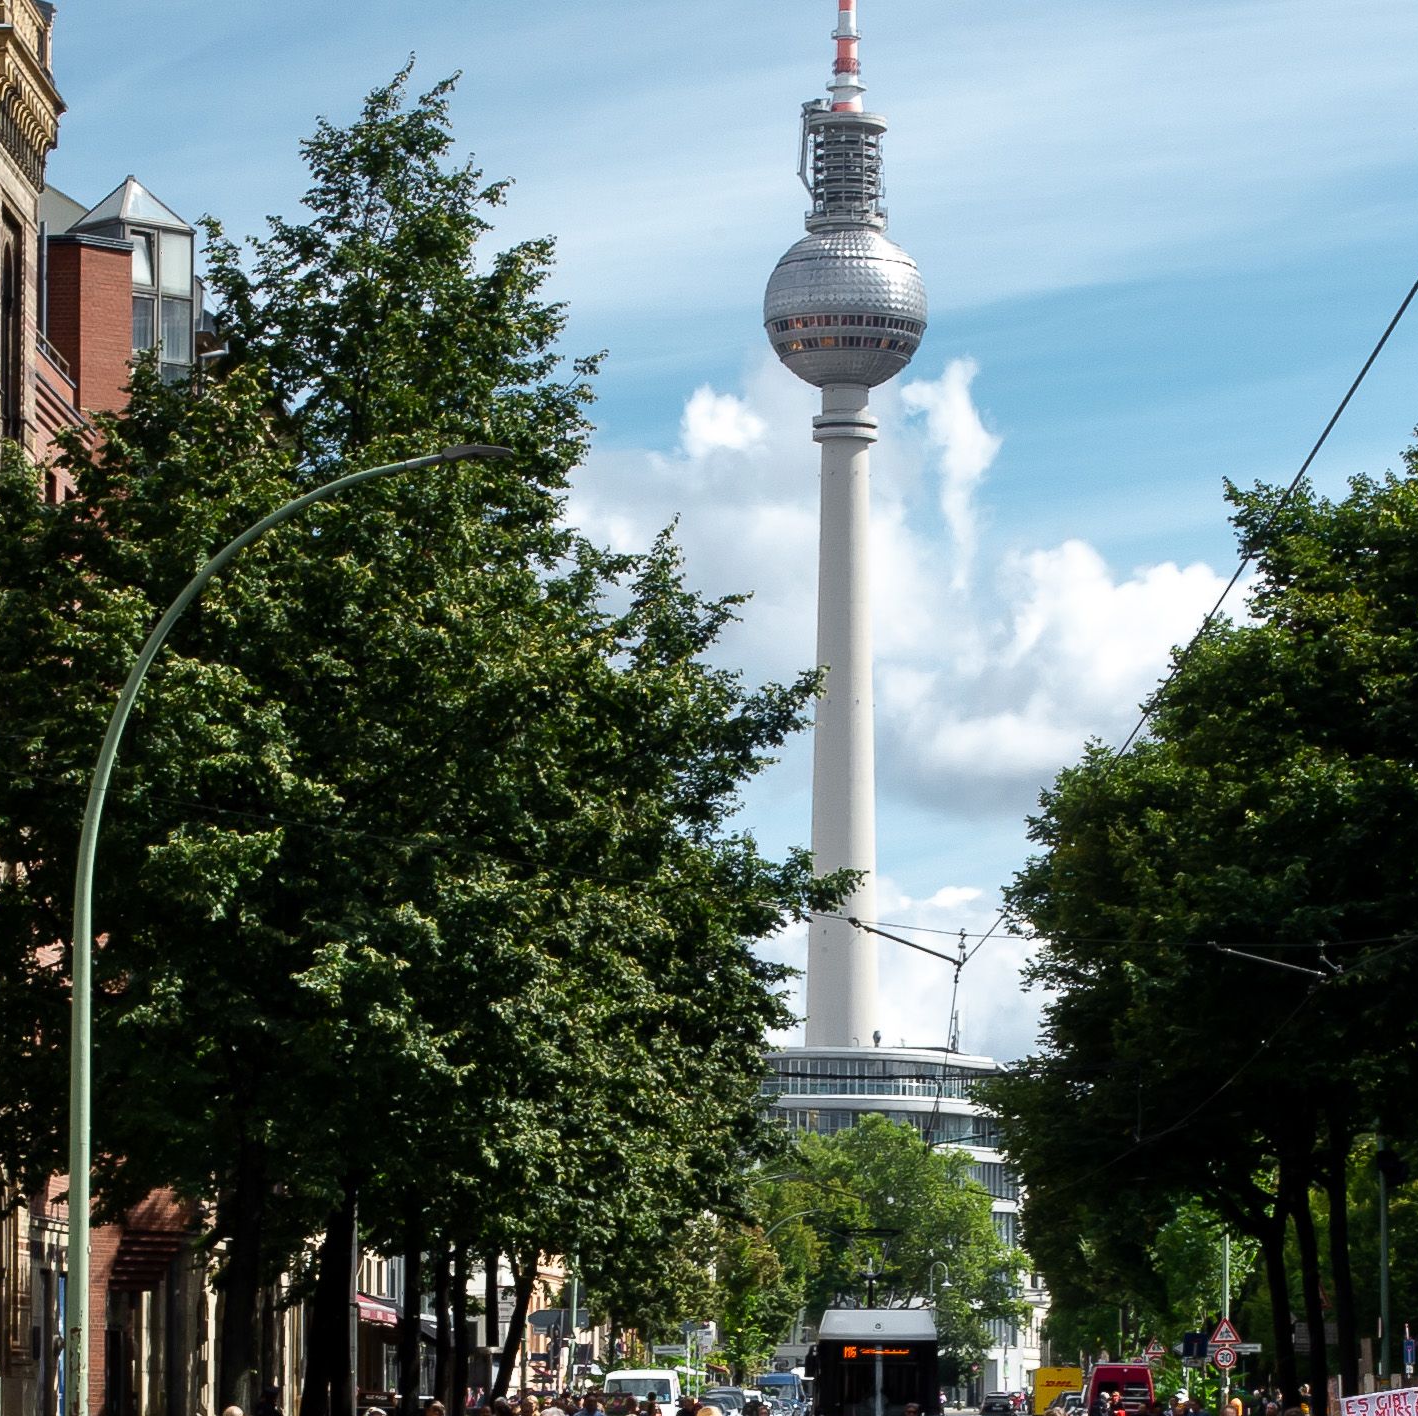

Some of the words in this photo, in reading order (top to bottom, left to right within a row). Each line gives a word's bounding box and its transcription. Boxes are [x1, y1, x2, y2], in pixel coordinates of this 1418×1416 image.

[1219, 1352, 1231, 1362] 30
[1345, 1397, 1369, 1414] ES
[1376, 1391, 1409, 1411] GIBT
